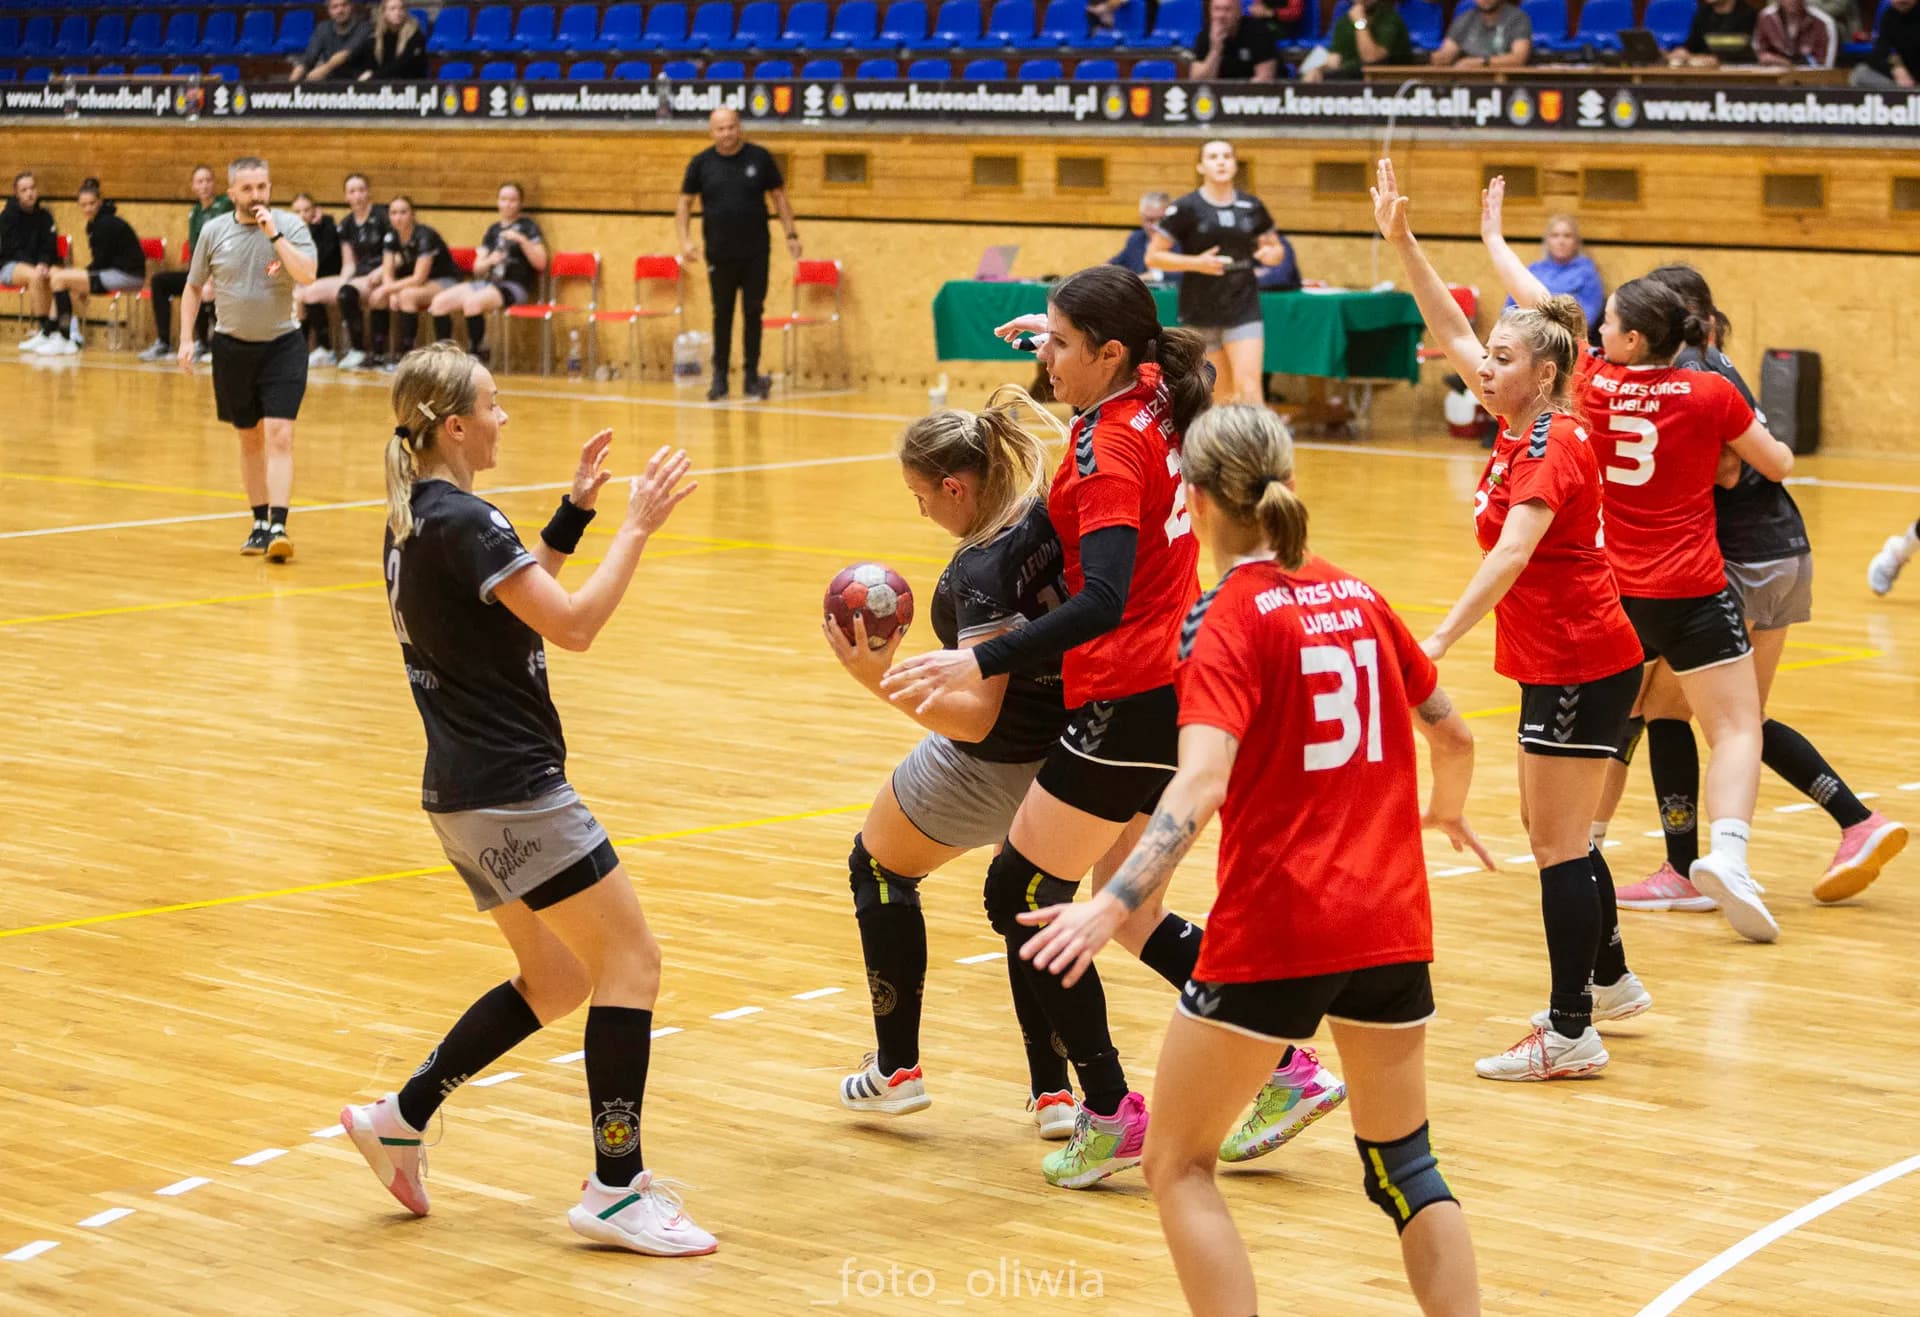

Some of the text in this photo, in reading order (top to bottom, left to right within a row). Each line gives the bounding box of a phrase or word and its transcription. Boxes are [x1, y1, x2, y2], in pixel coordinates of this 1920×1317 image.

[6, 85, 171, 117] www.korahandball.pl
[250, 84, 438, 117] www.koronahandball.pl
[853, 83, 1098, 121] www.koronahandball.pl
[1609, 397, 1660, 413] LUBLIN
[1619, 382, 1649, 397] AZS
[1606, 413, 1659, 487] 3
[1254, 585, 1294, 615] MKS
[1294, 583, 1332, 606] AZS
[1299, 607, 1363, 635] LUBLIN
[1300, 638, 1383, 772] 31
[479, 827, 522, 879] Pink
